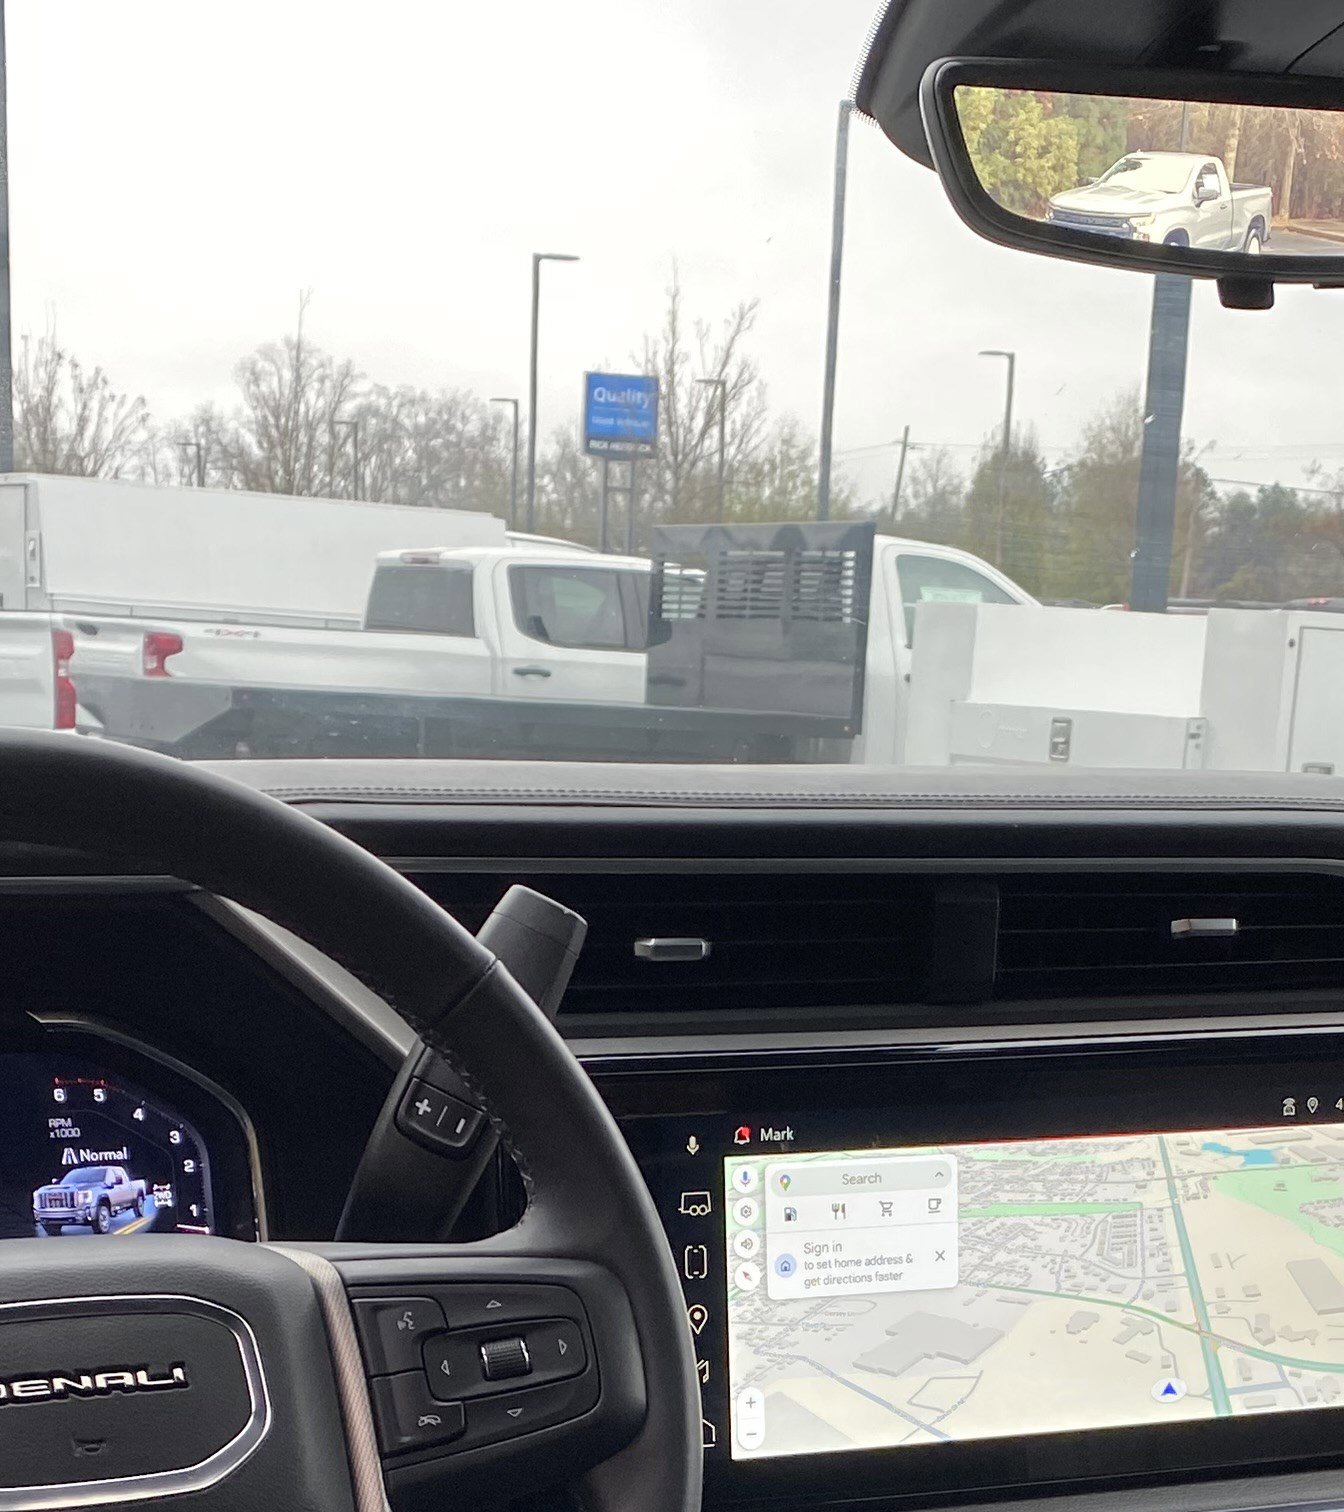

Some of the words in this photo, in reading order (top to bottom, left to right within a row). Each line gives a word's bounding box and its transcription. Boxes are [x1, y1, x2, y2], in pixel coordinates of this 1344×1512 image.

[593, 386, 650, 409] Quality
[53, 1088, 65, 1102] 6
[93, 1088, 105, 1102] 5
[133, 1107, 144, 1121] 4
[48, 1117, 72, 1128] RPM
[49, 1126, 81, 1139] x1000
[169, 1129, 181, 1144] 3
[760, 1125, 794, 1142] Mark
[79, 1146, 128, 1162] Normal
[183, 1159, 195, 1173] 2
[841, 1172, 883, 1186] Search
[189, 1203, 199, 1218] 1
[803, 1241, 830, 1257] Sign
[831, 1240, 843, 1253] in
[803, 1259, 815, 1270] to
[816, 1258, 832, 1270] set
[833, 1256, 863, 1268] home
[863, 1253, 904, 1267] address
[905, 1253, 914, 1264] &
[803, 1276, 821, 1288] get
[823, 1272, 873, 1287] directions
[874, 1270, 904, 1283] faster
